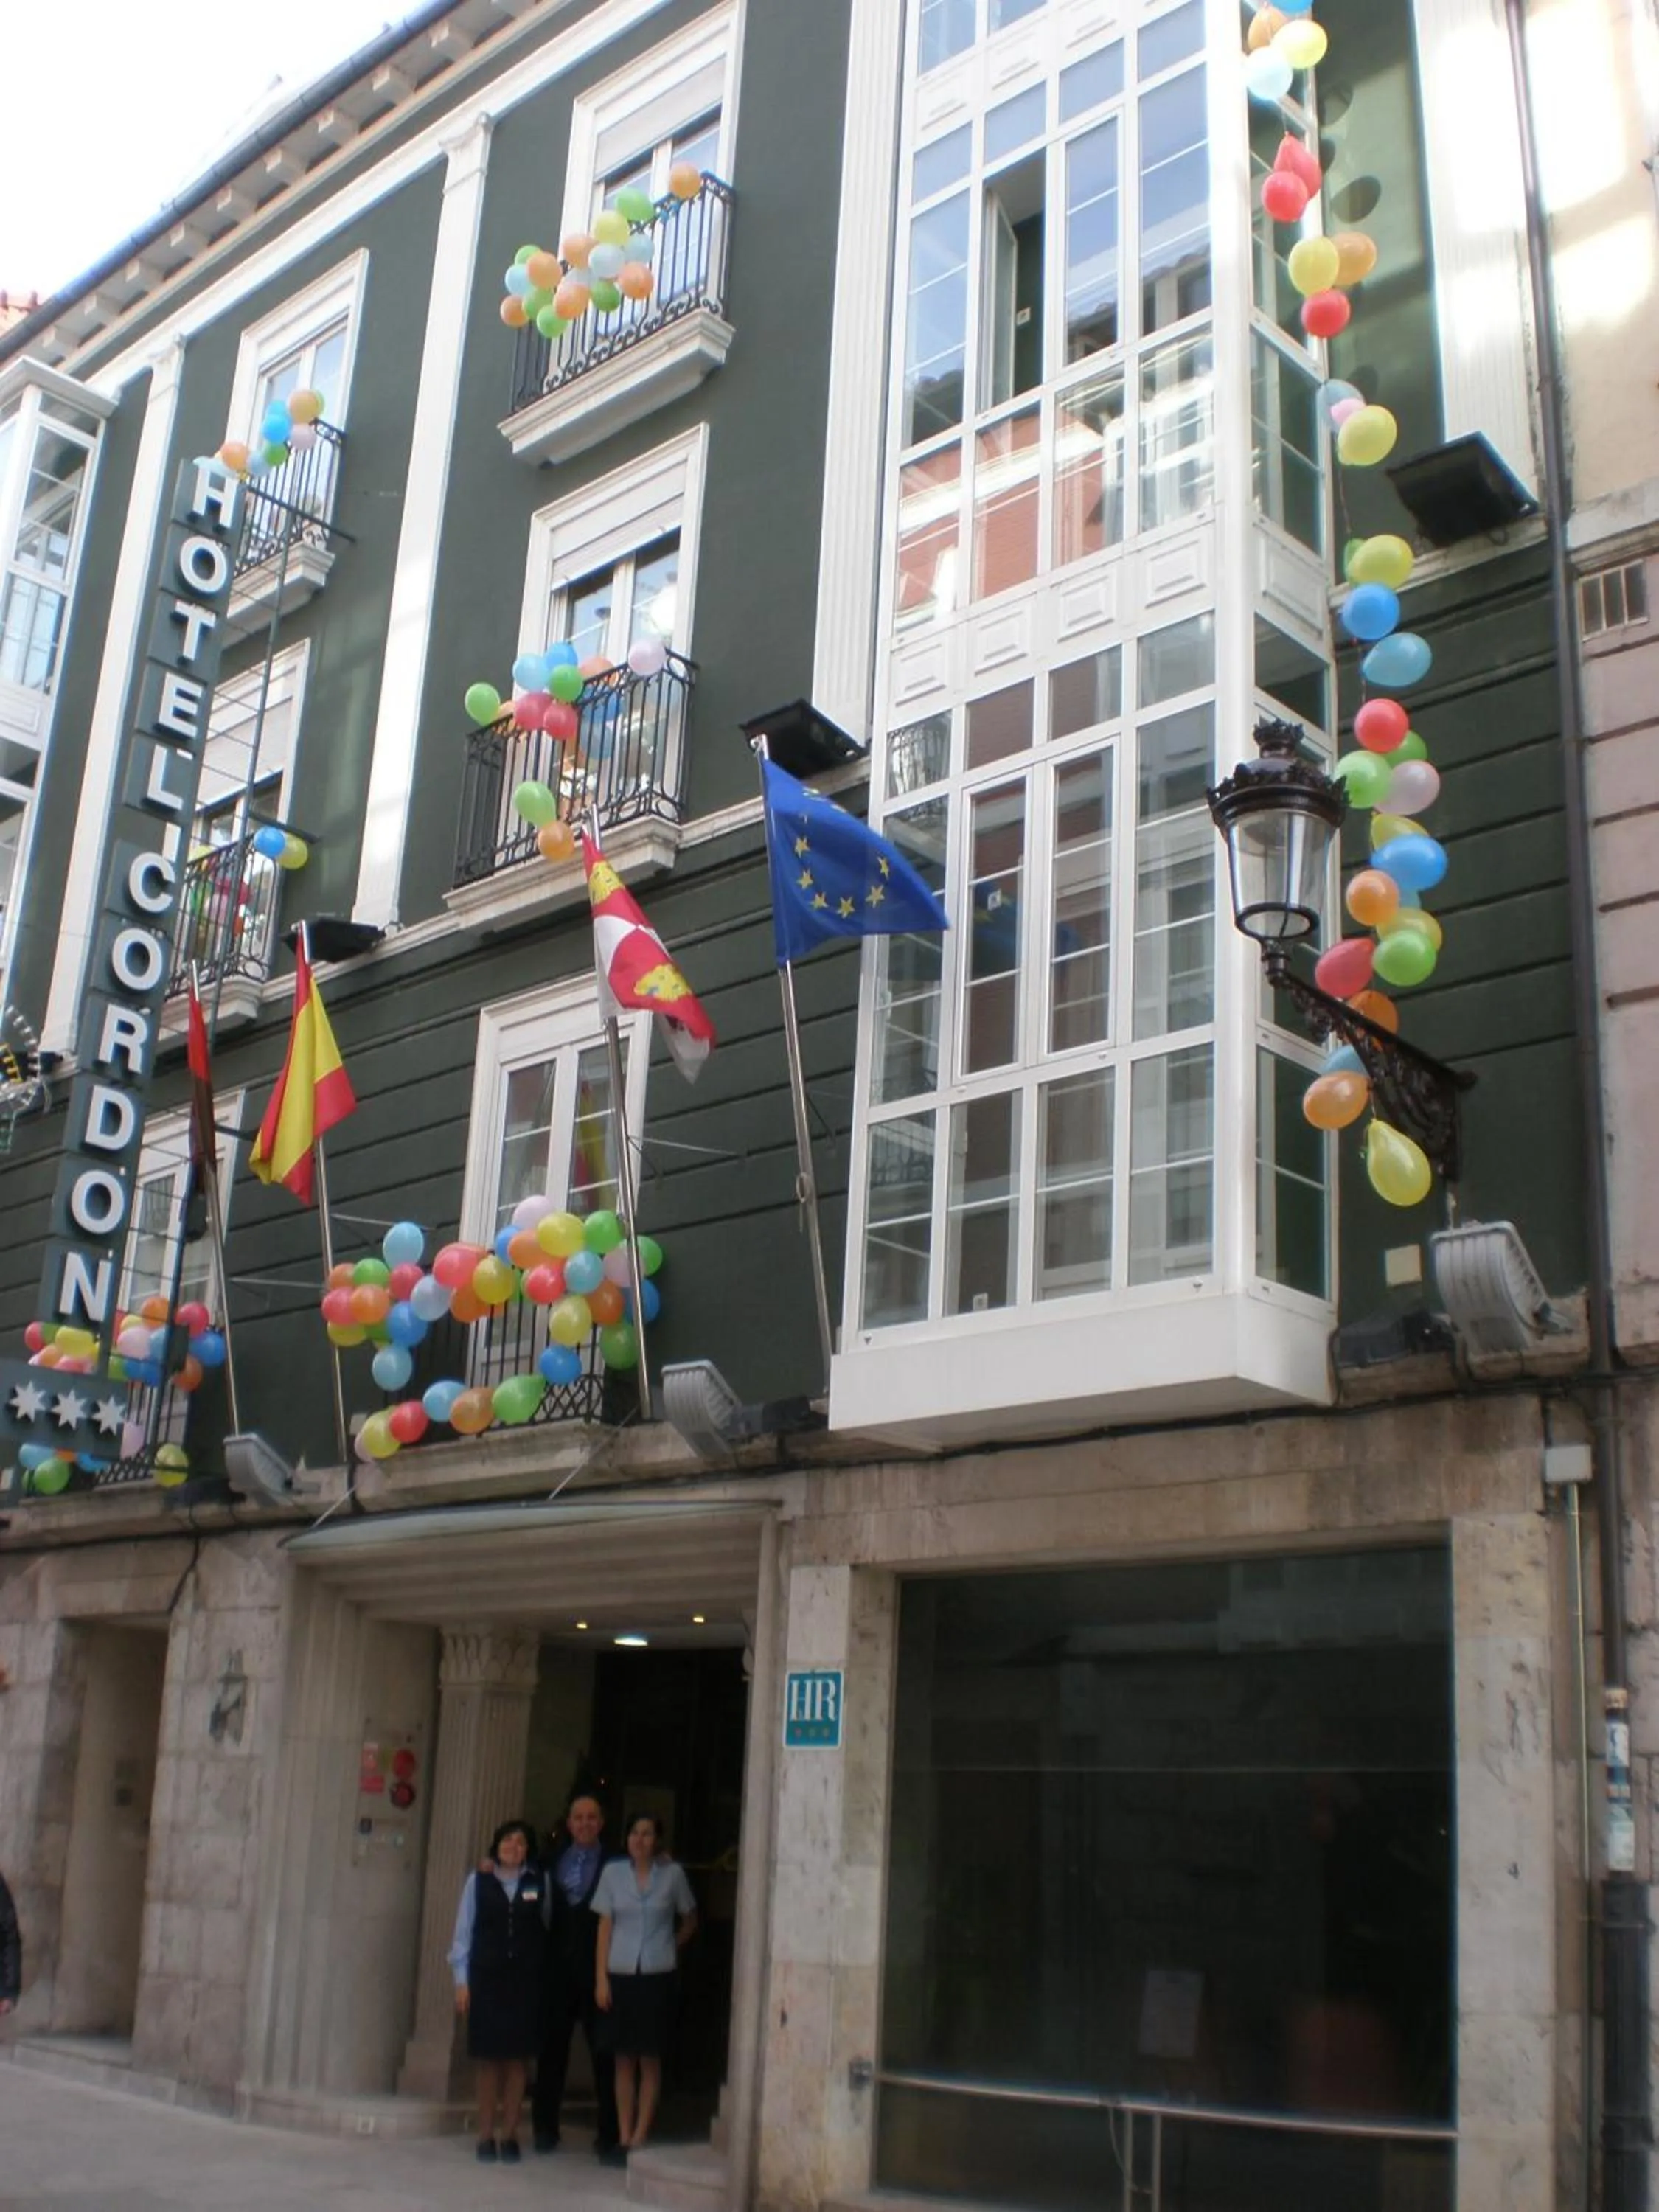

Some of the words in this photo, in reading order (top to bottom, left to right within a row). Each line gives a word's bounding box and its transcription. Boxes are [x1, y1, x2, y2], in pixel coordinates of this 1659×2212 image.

[147, 461, 240, 810] HOTEL
[59, 852, 177, 1322] CORDON
[790, 1678, 837, 1721] HR
